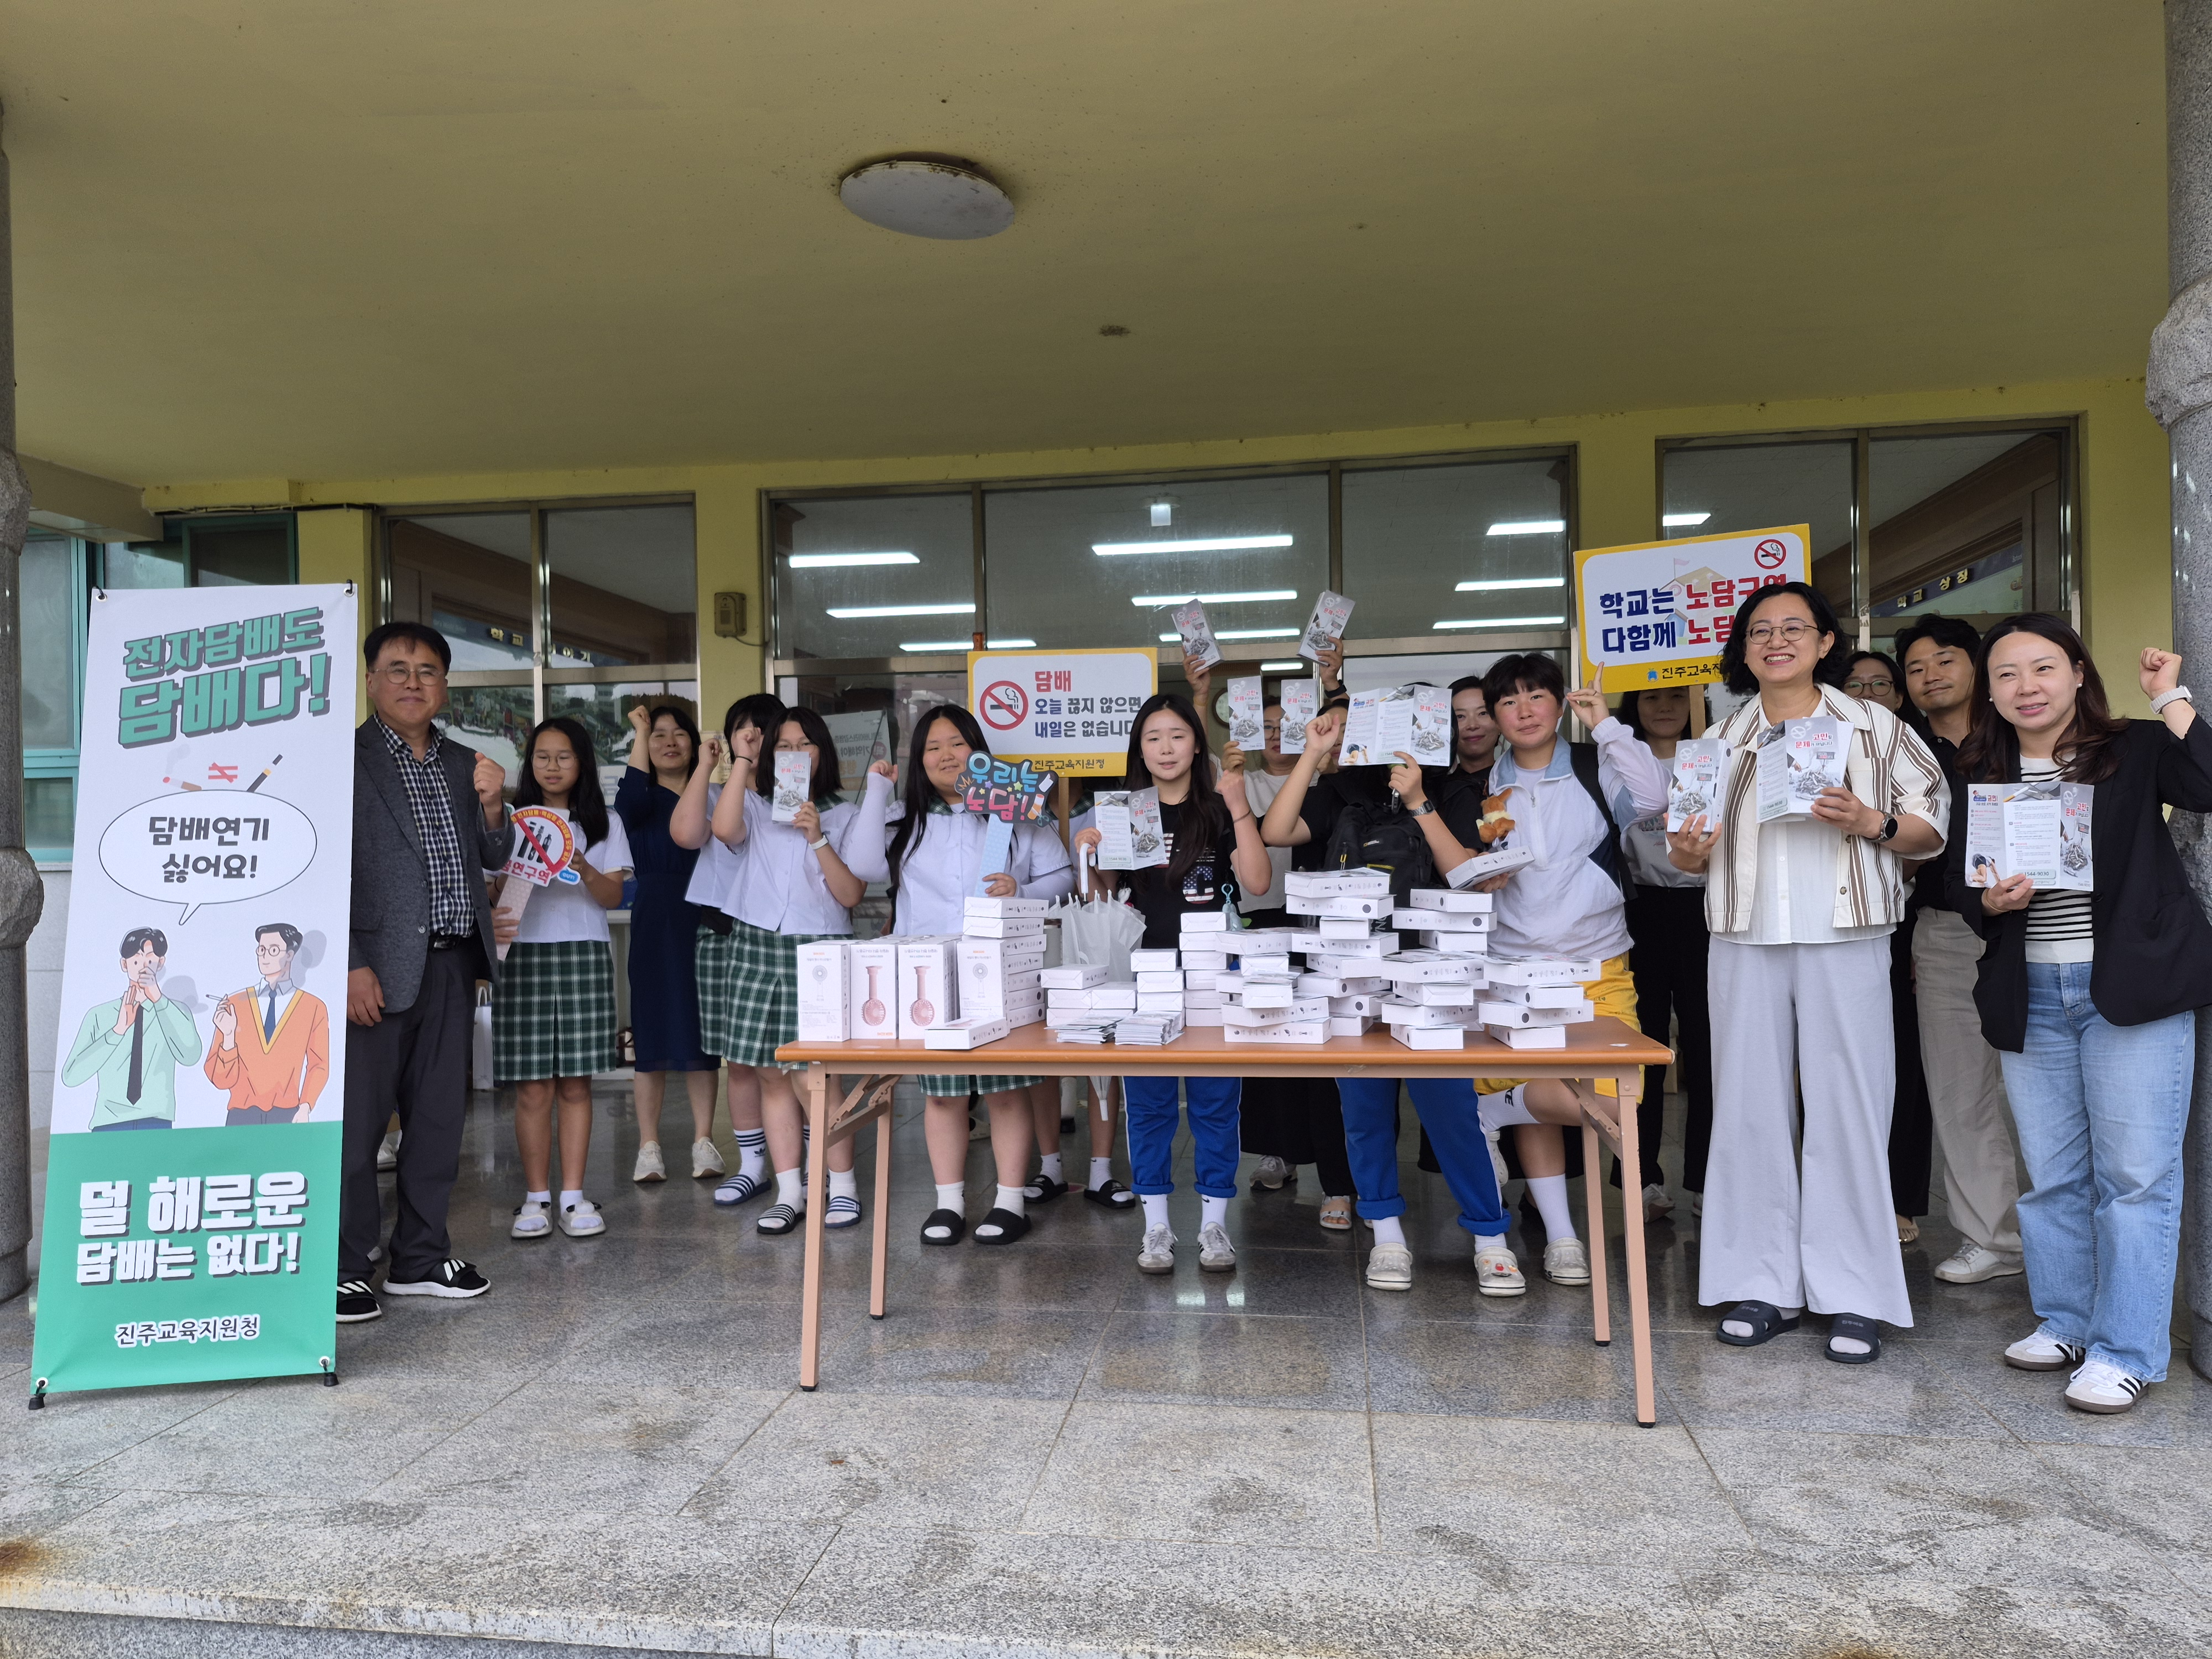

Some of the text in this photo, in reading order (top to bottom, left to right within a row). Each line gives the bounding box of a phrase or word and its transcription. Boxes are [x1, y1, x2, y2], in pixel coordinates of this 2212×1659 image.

[1599, 588, 1674, 619] 학교는
[1897, 568, 1969, 608] 학교 상징
[122, 607, 325, 681] 전자담배도
[491, 628, 524, 646] 학교
[1603, 614, 1735, 653] 다함께 노담
[1035, 670, 1071, 692] 담배
[118, 653, 332, 749] 담배다!
[1035, 697, 1141, 714] 오늘 끊지 않으면
[1035, 721, 1076, 738] 내일은
[969, 753, 1039, 793] 우리는
[1035, 759, 1105, 771] 진주교육지원청
[966, 786, 1030, 821] 노담!
[148, 816, 269, 846] 담배연기
[161, 853, 258, 883] 싫어요!
[79, 1171, 310, 1239] 덜 해로운
[76, 1231, 301, 1286] 담배는 없다!
[116, 1316, 260, 1346] 진주교육지원청
